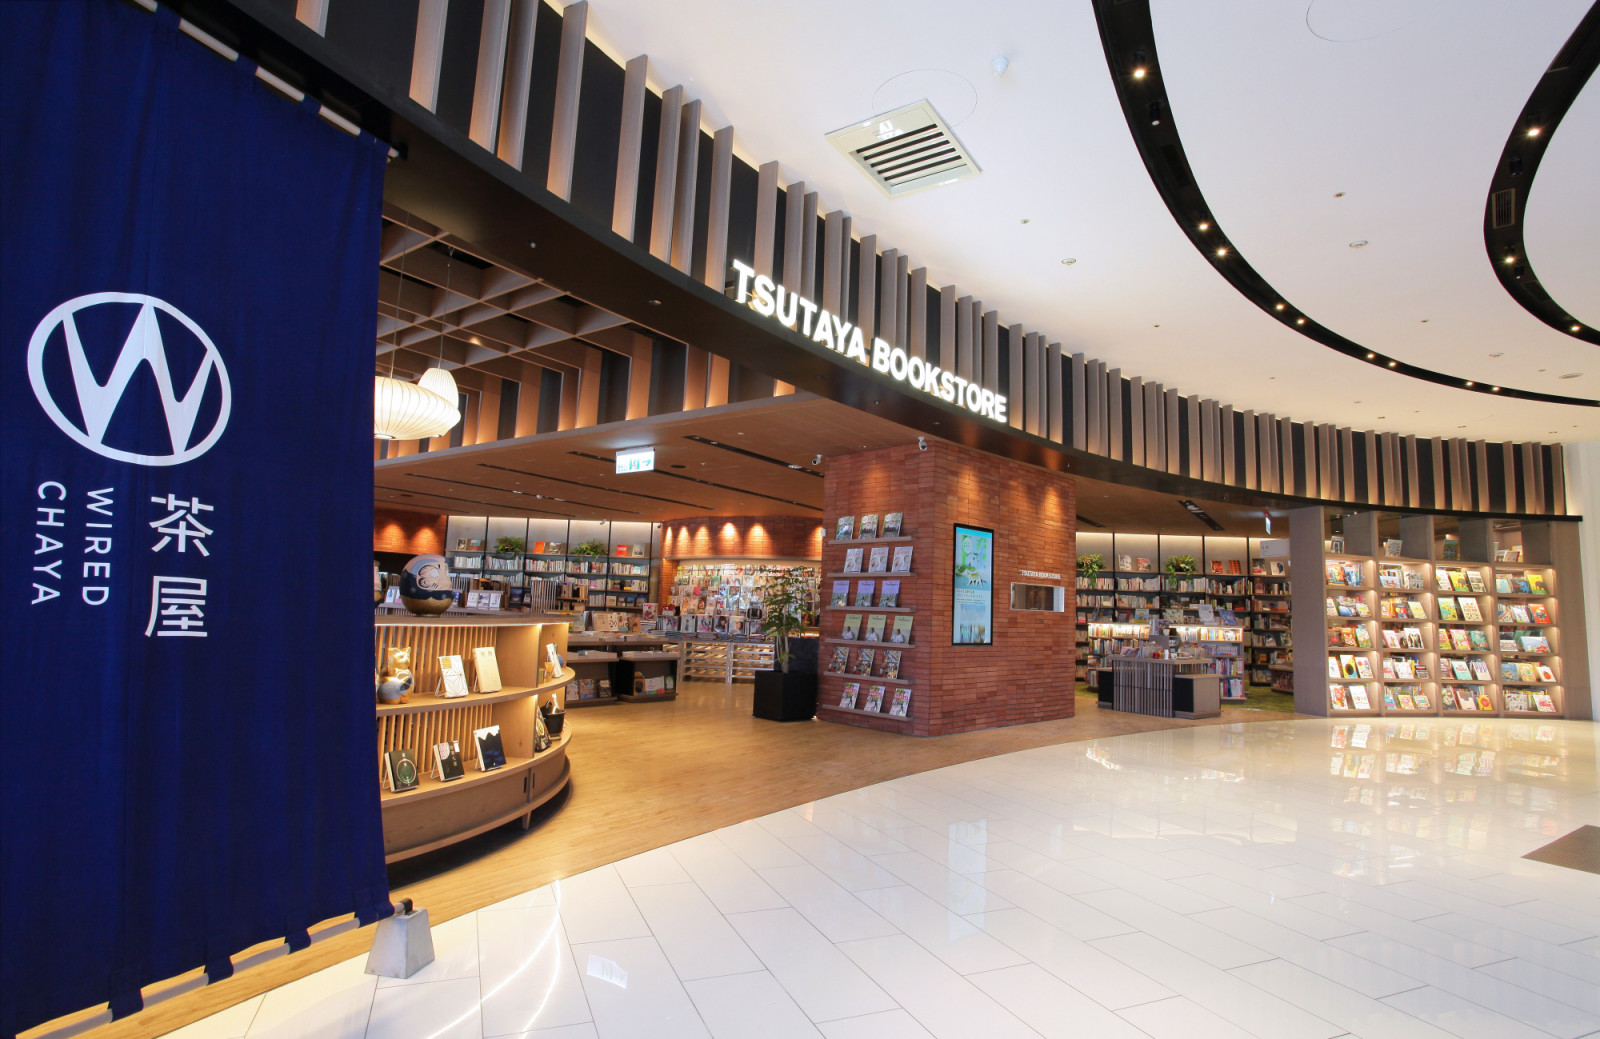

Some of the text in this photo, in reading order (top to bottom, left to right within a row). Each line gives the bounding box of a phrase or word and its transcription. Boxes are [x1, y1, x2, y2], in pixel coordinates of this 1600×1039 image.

[732, 259, 1007, 423] TSUTAYA BOOKSTORE
[32, 481, 67, 605] CHAYA
[82, 487, 114, 606] WIRED
[145, 493, 214, 638] 茶屋
